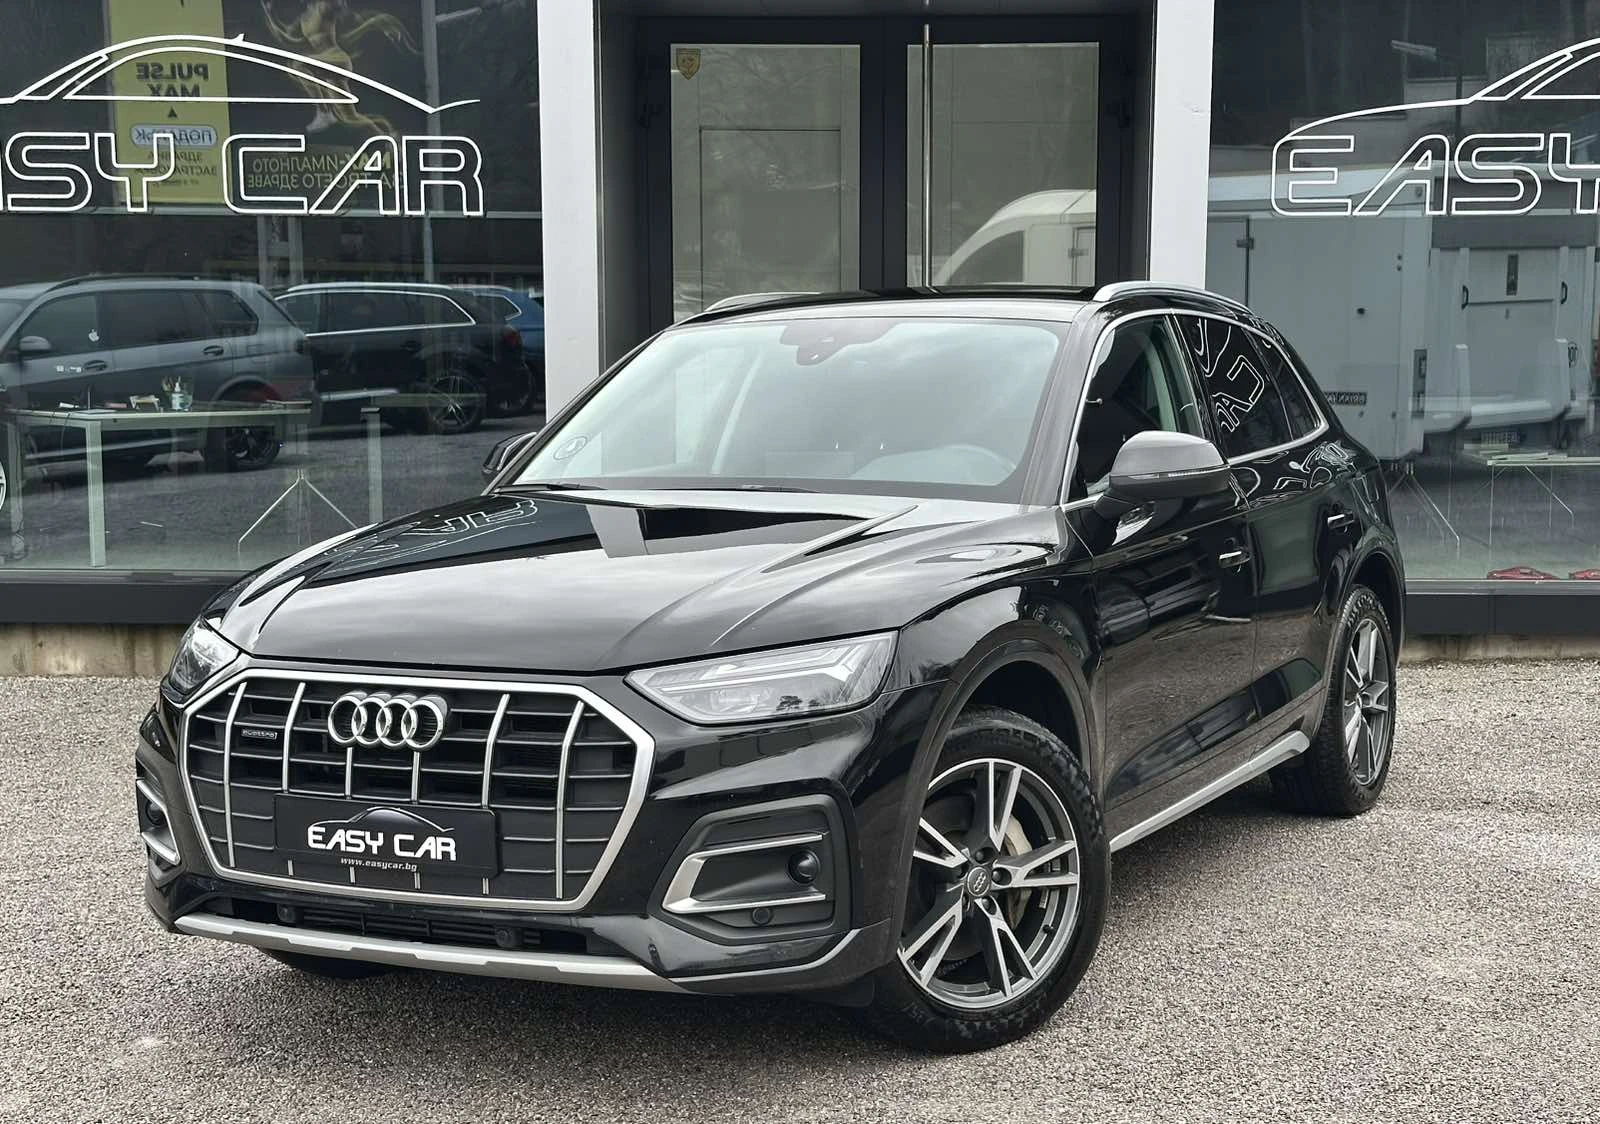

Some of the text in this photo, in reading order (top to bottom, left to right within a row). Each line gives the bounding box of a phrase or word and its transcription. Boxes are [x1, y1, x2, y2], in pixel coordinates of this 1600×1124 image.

[0, 132, 484, 216] SY CAR
[1271, 132, 1600, 216] EASY
[307, 825, 457, 861] EASY CAR
[340, 857, 418, 871] www.easycar.bg
